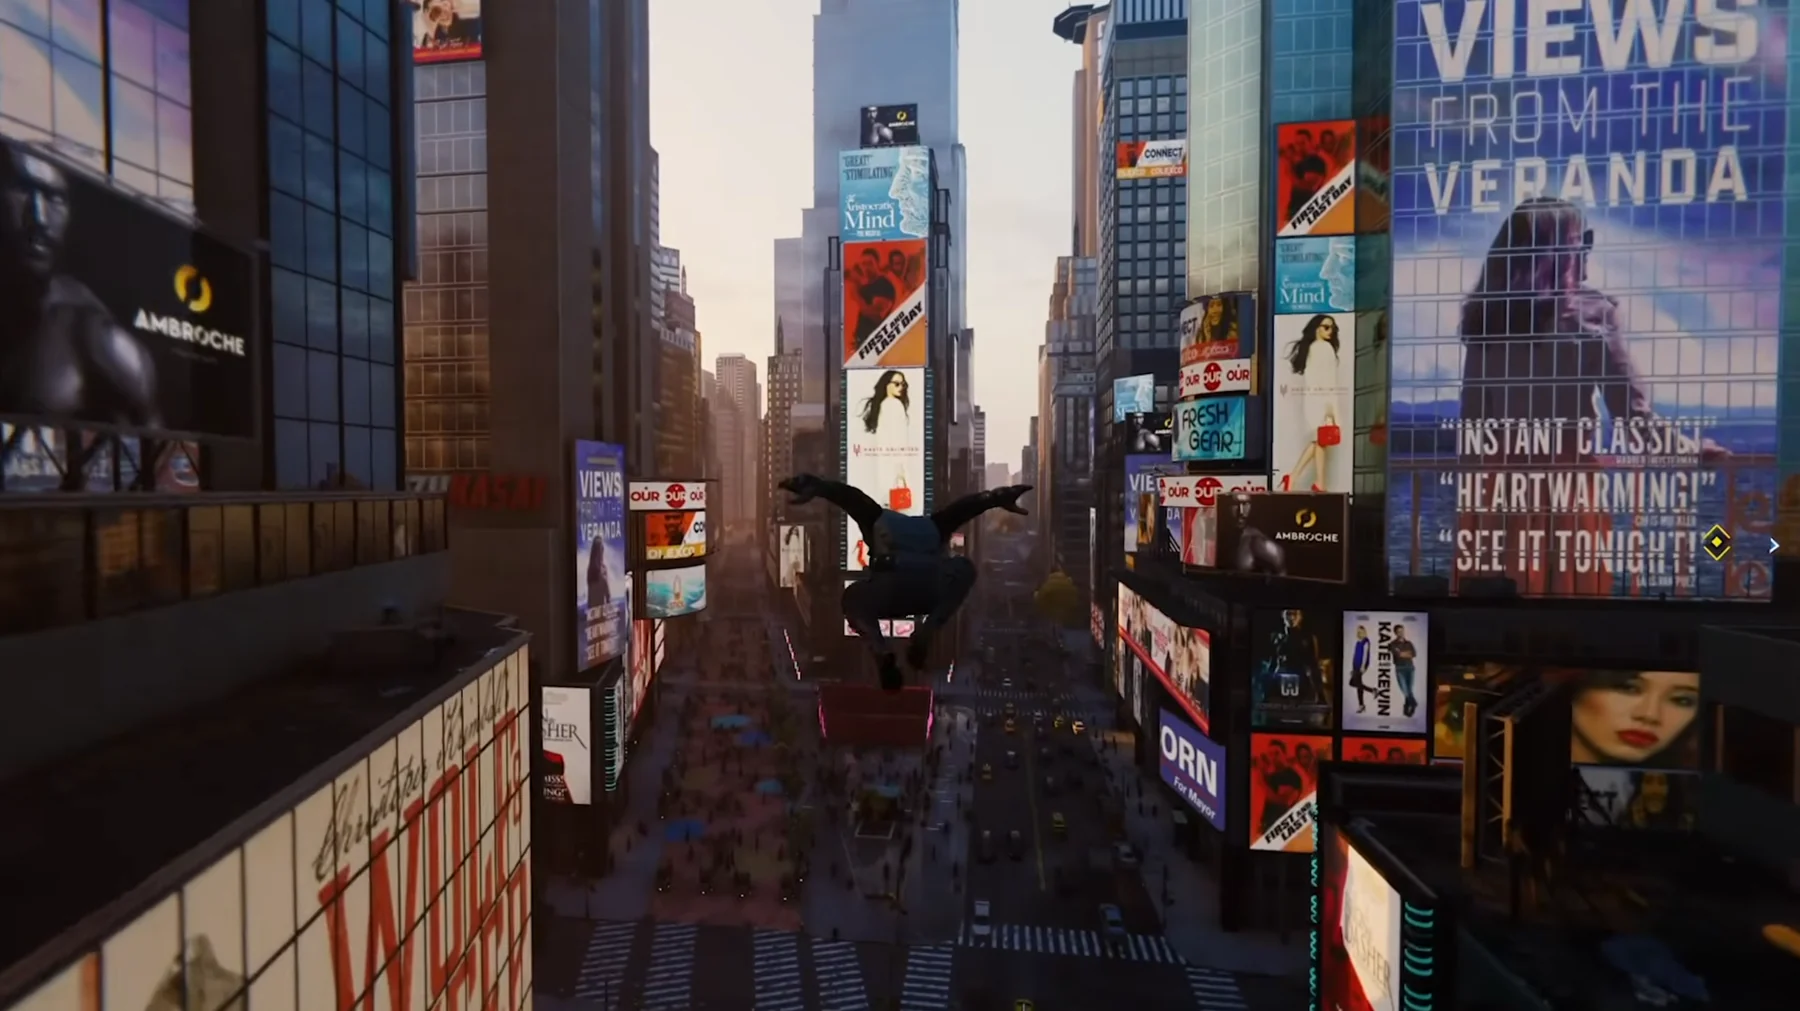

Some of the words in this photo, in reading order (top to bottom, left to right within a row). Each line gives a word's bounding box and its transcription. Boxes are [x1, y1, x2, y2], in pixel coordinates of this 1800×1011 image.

[1420, 0, 1757, 83] VIEWS
[1429, 86, 1598, 148] FROM
[1630, 76, 1753, 136] THE
[1144, 147, 1183, 159] CONNECT
[1423, 145, 1748, 216] VERANDA
[1291, 198, 1329, 230] FIRST
[1305, 198, 1334, 226] LAST
[1331, 175, 1353, 202] DAY
[844, 209, 896, 230] Mind
[1280, 287, 1325, 304] Mind
[133, 307, 246, 357] AMBROCHE
[858, 323, 898, 360] FIRST
[874, 325, 909, 356] LAST
[902, 300, 923, 329] DAY
[1185, 371, 1200, 387] OUR
[1226, 365, 1250, 381] OUR
[1182, 402, 1229, 431] FRESH
[1189, 429, 1235, 453] GEAR
[1441, 417, 1564, 456] "INSTANT
[580, 469, 622, 499] VIEWS
[631, 487, 660, 502] OUR
[1168, 482, 1189, 498] OUR
[1440, 471, 1717, 514] "HEARTWARMING!"
[580, 520, 622, 542] VERANDA
[1275, 531, 1339, 543] AMBROCHE
[1438, 529, 1506, 571] "SEE
[1518, 530, 1545, 571] IT
[1377, 621, 1392, 661] KATE
[1377, 668, 1391, 717] KEVIN
[1161, 725, 1217, 798] ORN
[1173, 776, 1189, 796] For
[1187, 785, 1216, 819] Mayor
[1264, 812, 1297, 844] FIRST
[1281, 814, 1309, 842] LAST
